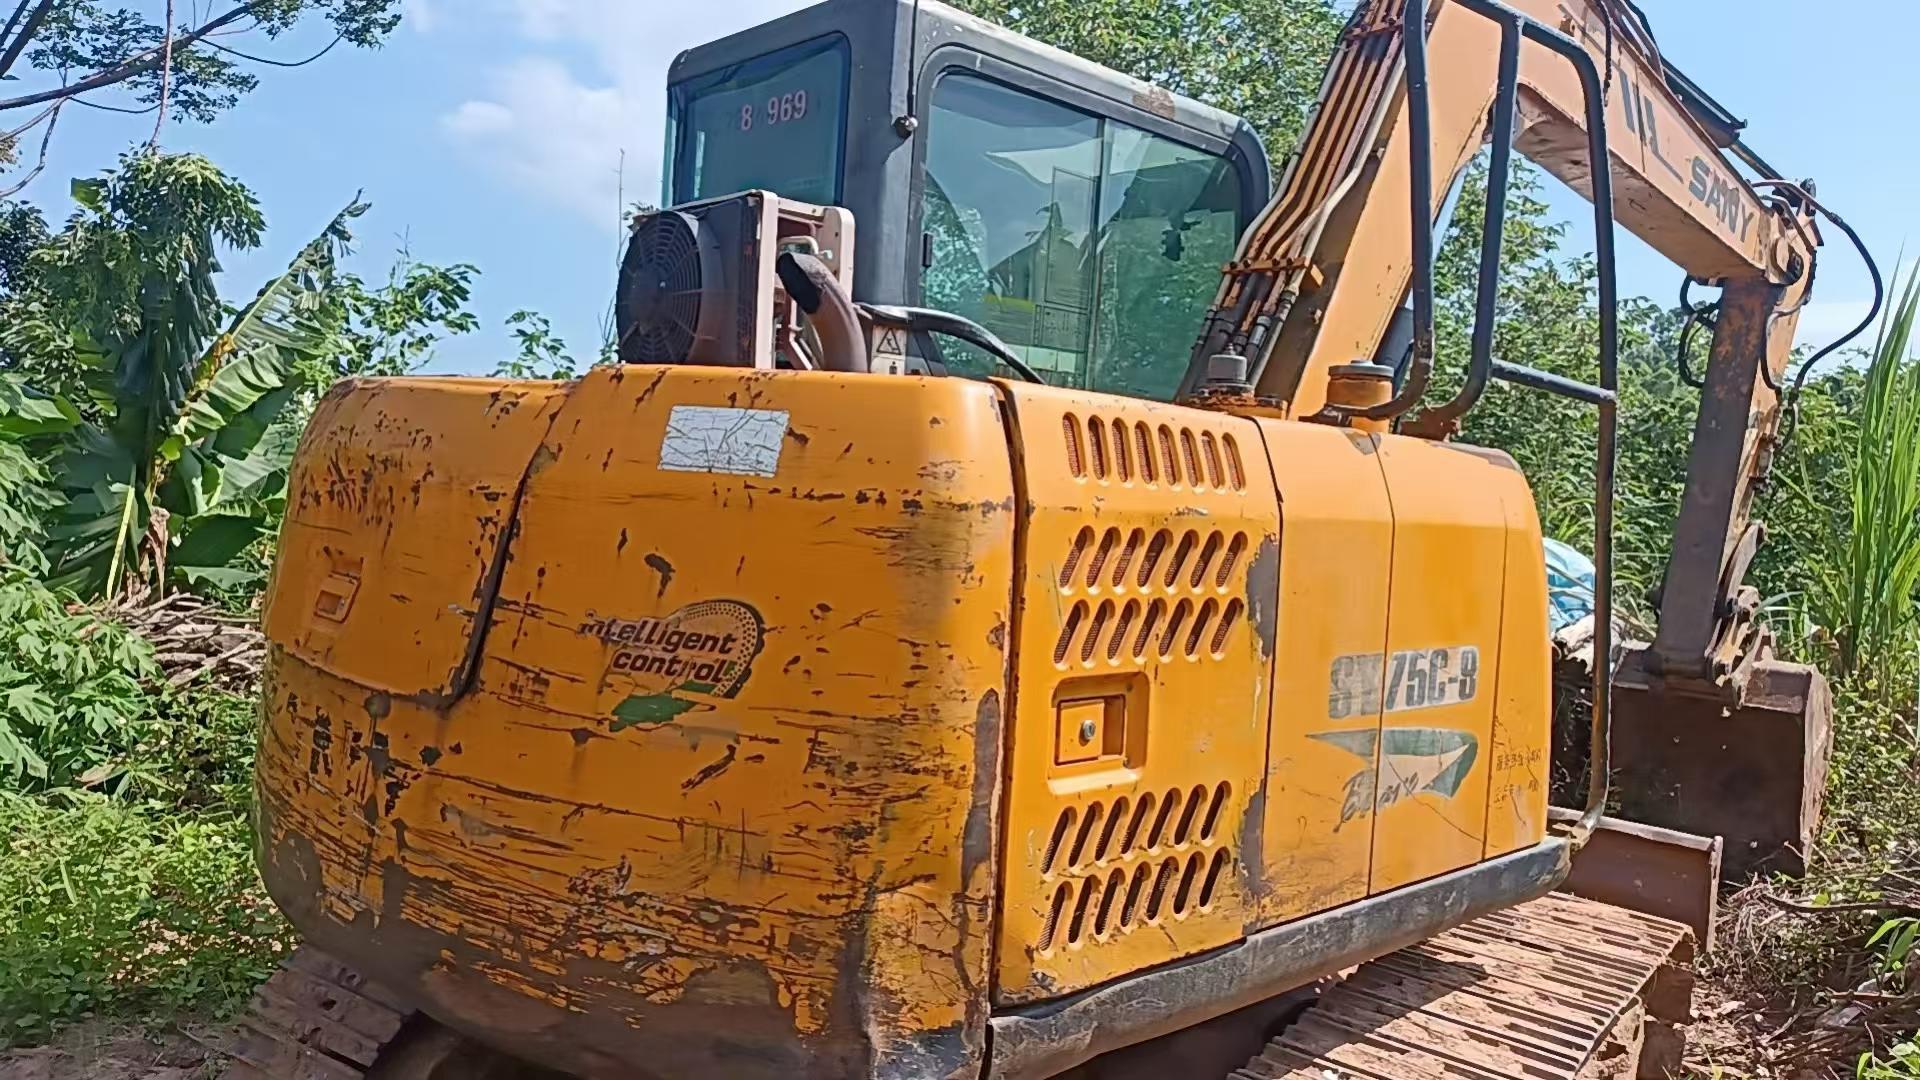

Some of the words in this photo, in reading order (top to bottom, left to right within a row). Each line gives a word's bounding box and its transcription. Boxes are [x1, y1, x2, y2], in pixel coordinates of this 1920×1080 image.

[767, 90, 807, 125] 969
[1689, 156, 1755, 243] SANY
[577, 609, 738, 655] intelligent
[613, 651, 728, 684] control
